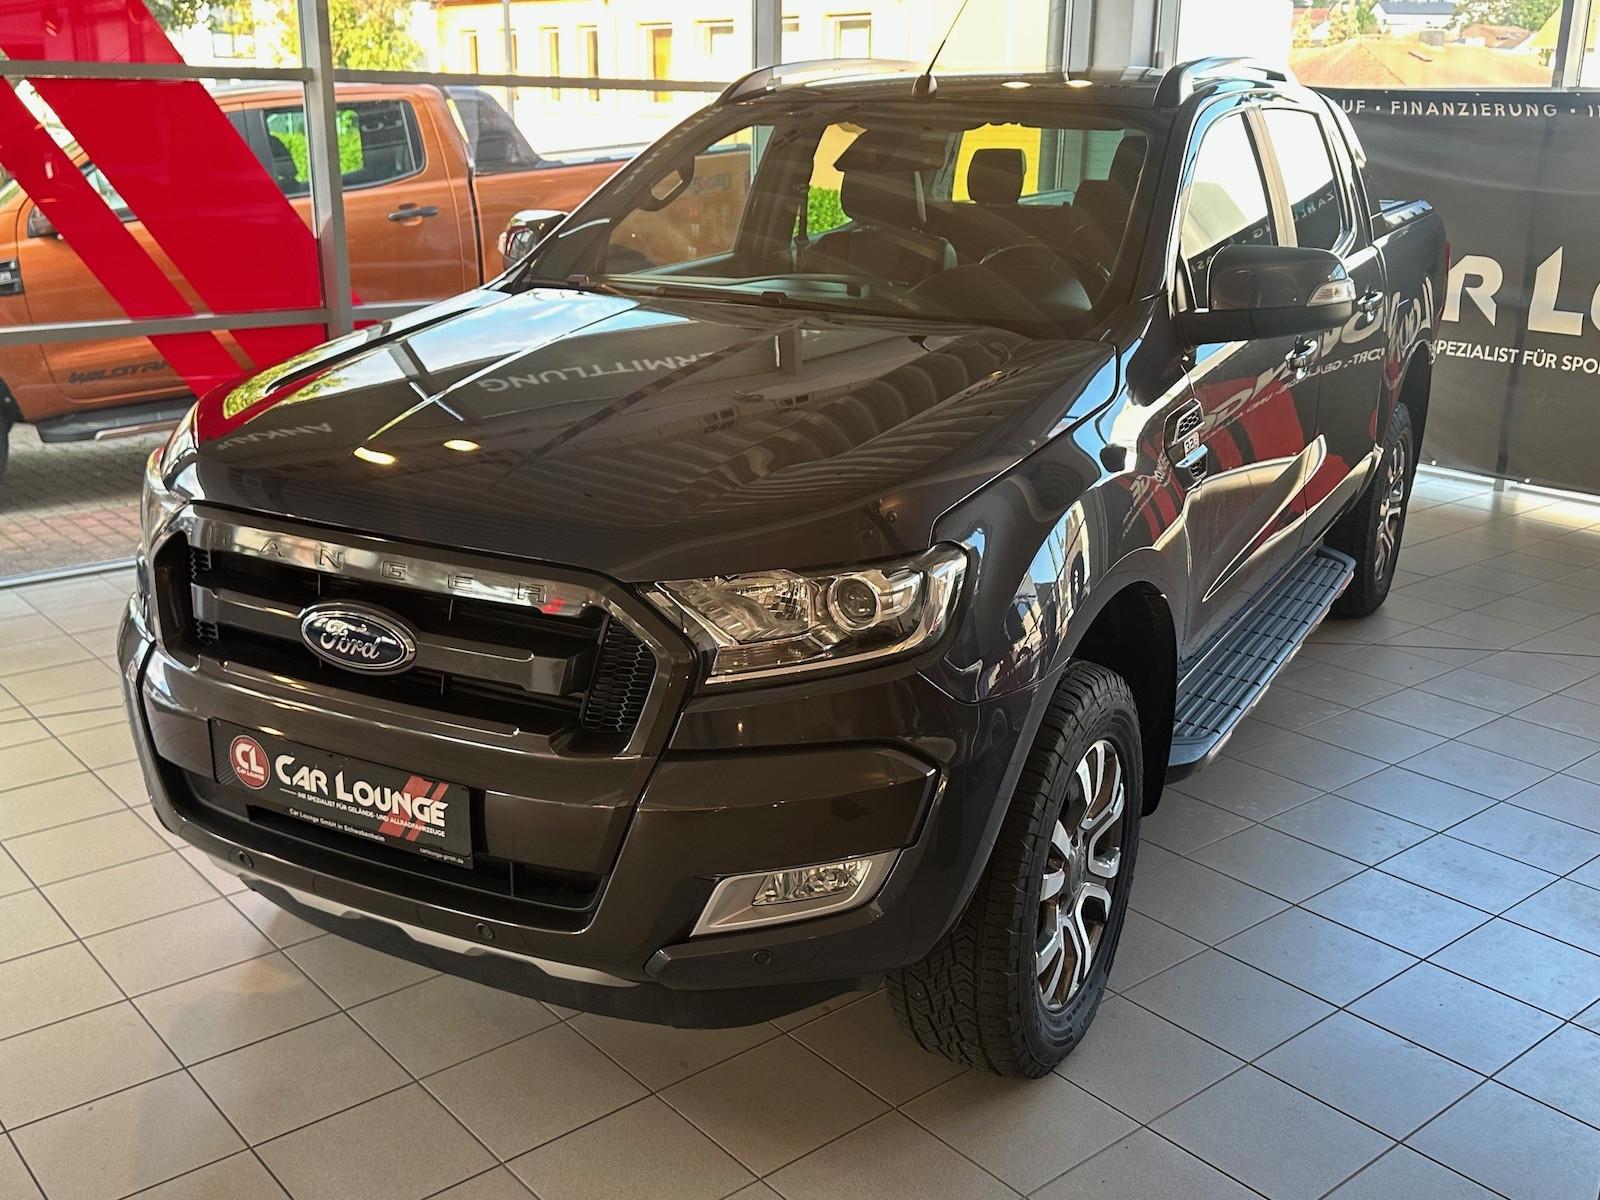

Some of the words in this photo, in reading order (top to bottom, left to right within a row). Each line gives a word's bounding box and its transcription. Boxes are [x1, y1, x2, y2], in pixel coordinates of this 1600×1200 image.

[1390, 100, 1558, 118] FINANZIERUNG
[1527, 245, 1600, 337] L
[1522, 348, 1558, 370] FÜR
[1560, 354, 1600, 376] SPO
[318, 616, 383, 661] Ford
[235, 742, 265, 776] CL
[275, 754, 329, 796] CAR
[334, 770, 449, 828] LOUNGE
[289, 807, 300, 816] Car
[299, 811, 320, 824] Lounge
[319, 817, 337, 828] GmbH
[343, 824, 386, 843] Schwabenheim
[307, 794, 335, 808] SPEZIALIST
[389, 817, 446, 838] ALLRADFAHRZEUGE
